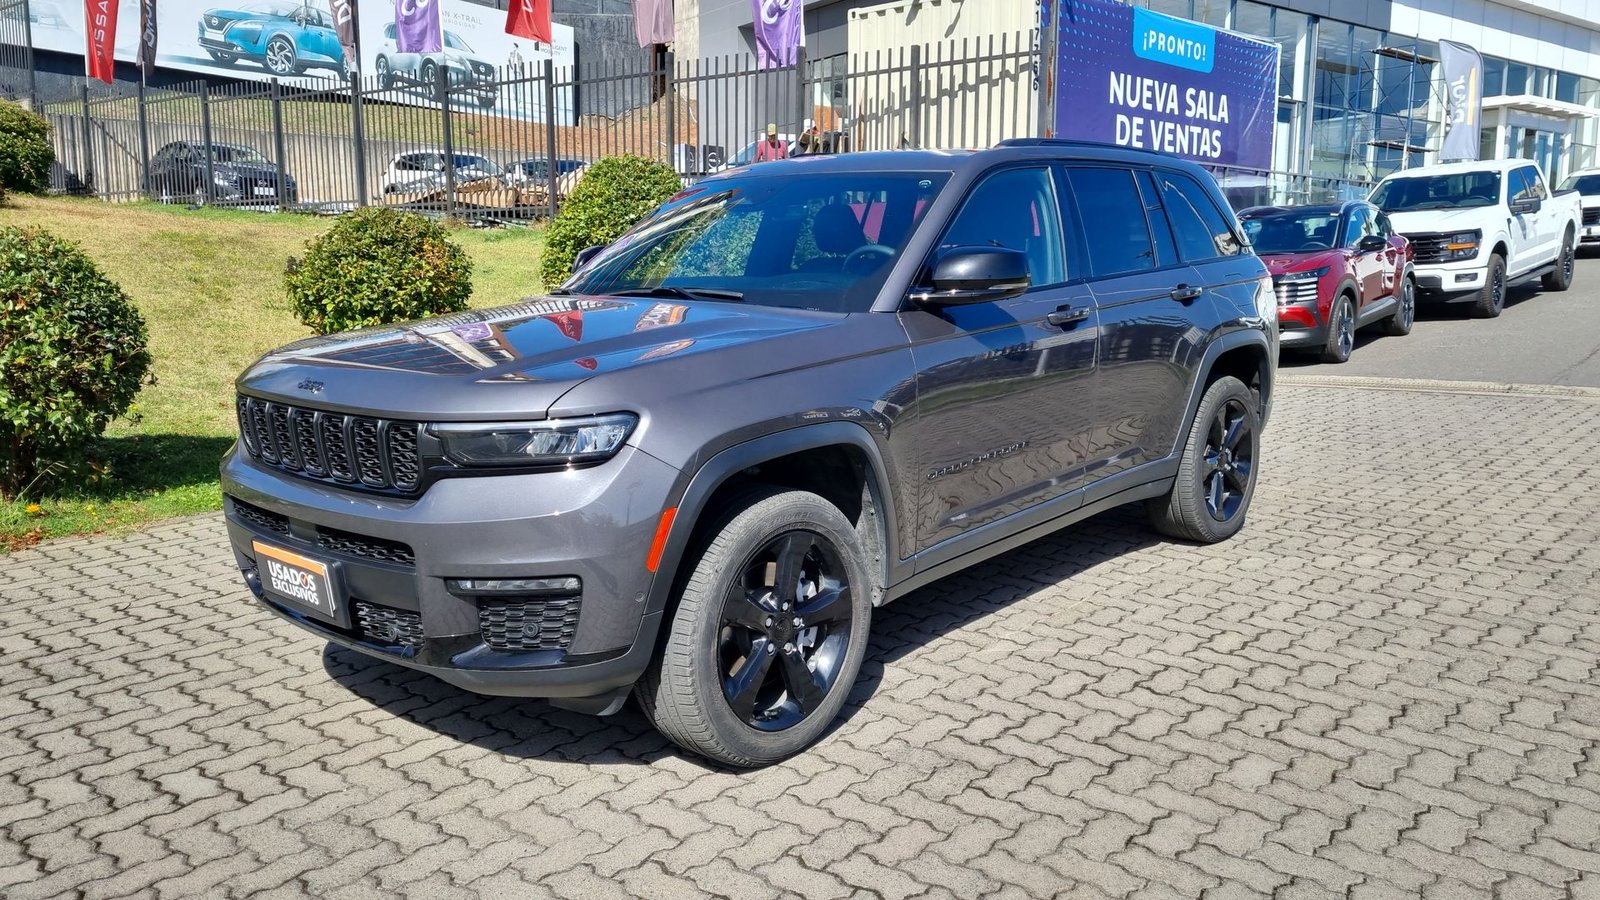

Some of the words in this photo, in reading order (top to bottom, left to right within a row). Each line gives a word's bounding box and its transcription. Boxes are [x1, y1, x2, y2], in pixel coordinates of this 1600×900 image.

[1143, 30, 1206, 62] ¡PRONTO!
[1109, 71, 1179, 115] NUEVA
[1185, 87, 1229, 124] SALA
[1115, 114, 1144, 149] DE
[1150, 119, 1222, 159] VENTAS
[267, 560, 317, 592] USADOS
[271, 577, 320, 606] EXCLUSIVOS
